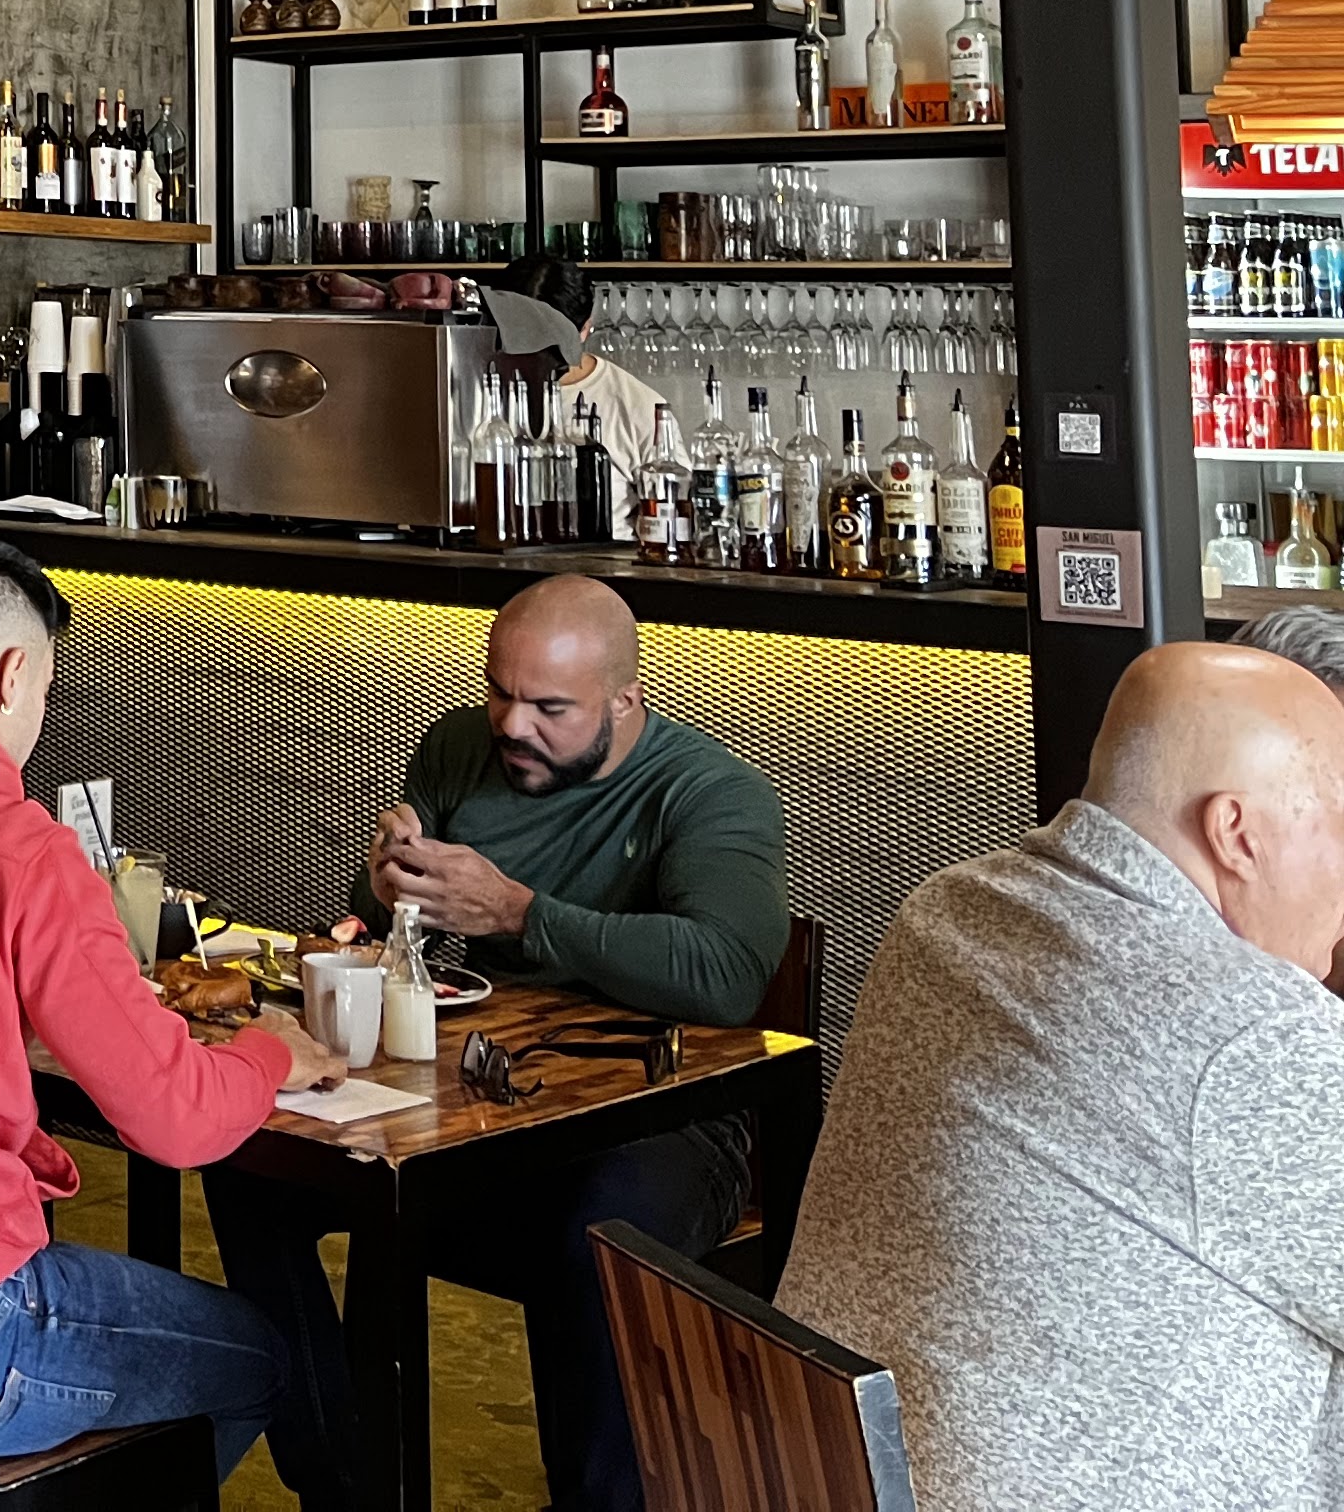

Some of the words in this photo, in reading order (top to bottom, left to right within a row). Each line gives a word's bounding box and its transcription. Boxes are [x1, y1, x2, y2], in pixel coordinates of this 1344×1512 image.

[1249, 144, 1344, 175] TECA
[1061, 531, 1080, 542] SAN
[1082, 531, 1116, 545] MIGUEL
